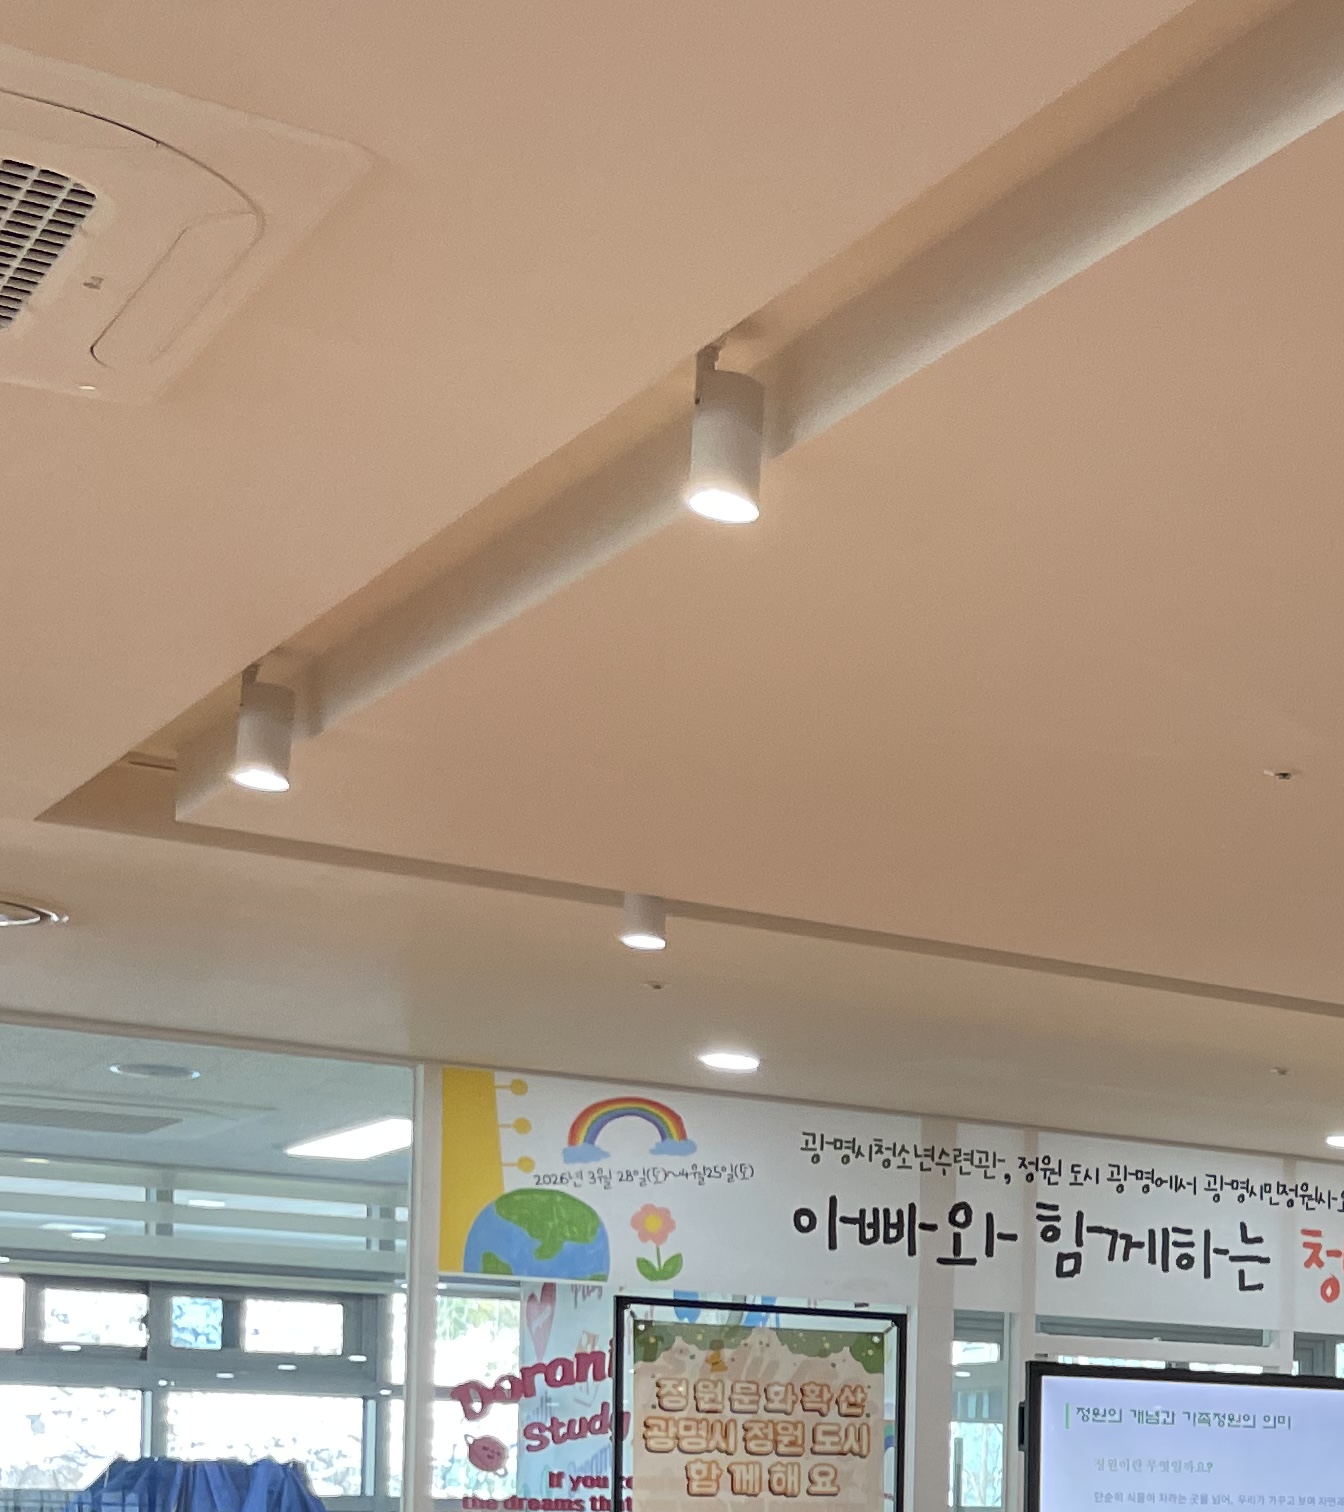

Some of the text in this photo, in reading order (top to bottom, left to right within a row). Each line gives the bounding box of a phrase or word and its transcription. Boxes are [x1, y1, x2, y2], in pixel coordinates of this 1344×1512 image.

[533, 1171, 584, 1188] 2026년
[588, 1167, 613, 1190] 3월
[800, 1131, 1011, 1185] 광명시청소년수련관,
[1018, 1155, 1062, 1187] 정원
[1069, 1163, 1100, 1187] 도시
[1106, 1163, 1197, 1195] 광명에서
[793, 1195, 1018, 1266] 아빠와
[1035, 1201, 1271, 1291] 함께하는
[643, 1416, 871, 1458] 광명시 정원 도시
[1076, 1407, 1292, 1430] 정원의 개념과 가족정원의 의미
